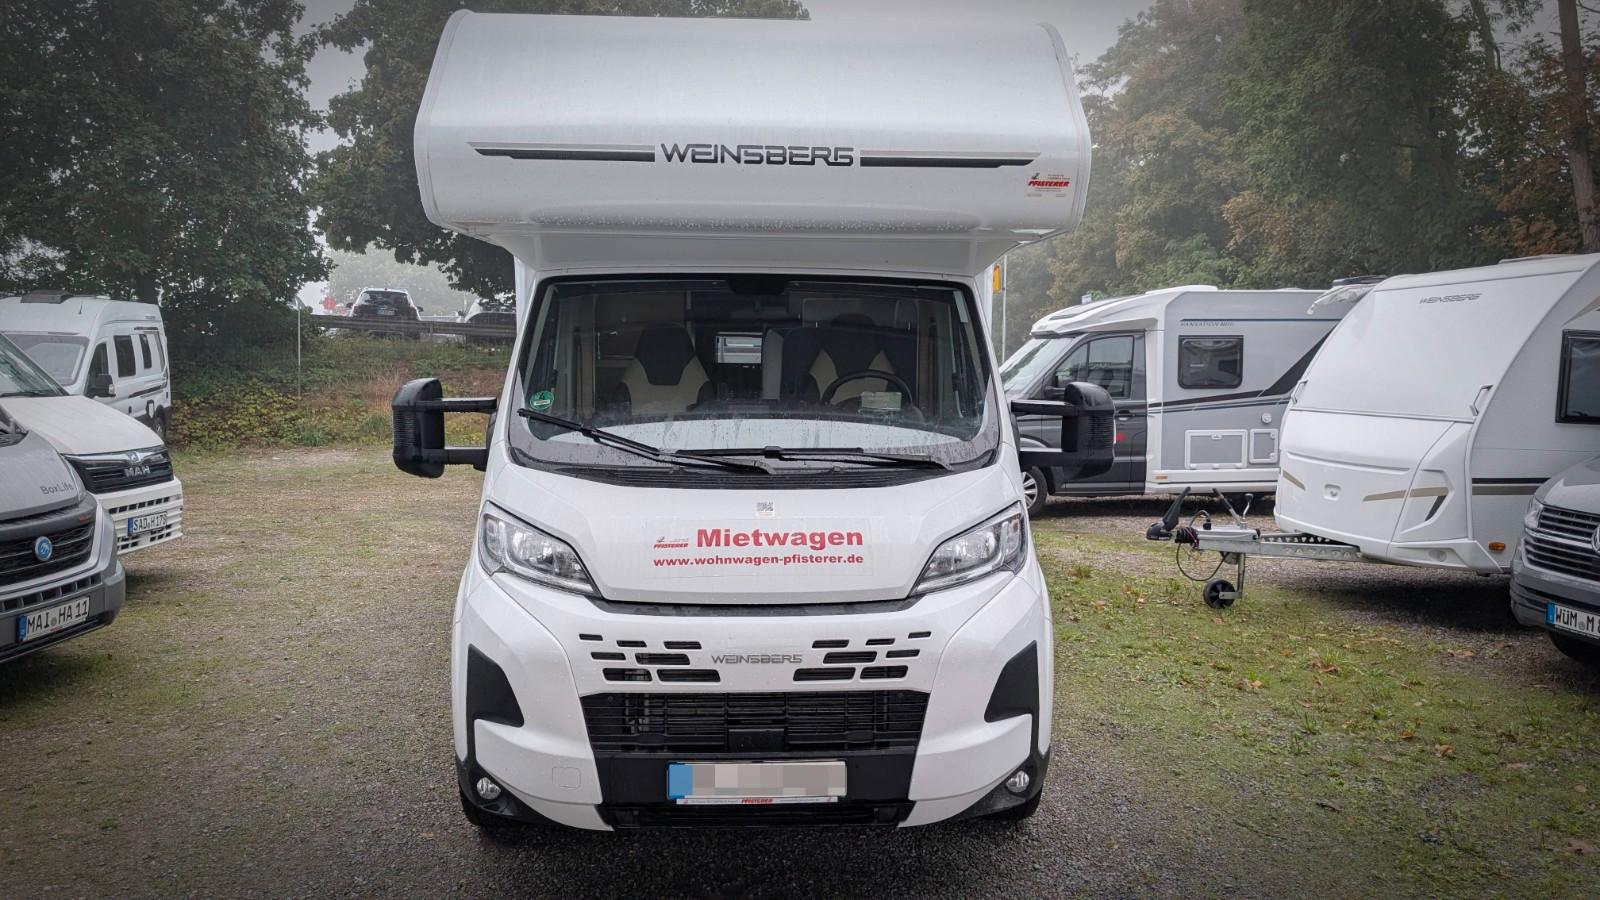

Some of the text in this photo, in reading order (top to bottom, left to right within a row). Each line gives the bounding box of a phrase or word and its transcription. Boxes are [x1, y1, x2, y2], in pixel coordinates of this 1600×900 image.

[661, 143, 854, 166] WEINSBERG
[697, 528, 863, 550] Mietwagen
[653, 554, 863, 566] www.wohnwagen-pfisterer.de
[27, 611, 50, 635] MAI
[58, 604, 73, 624] HA
[1556, 607, 1578, 627] WÜM
[711, 654, 803, 664] WEINSBERG
